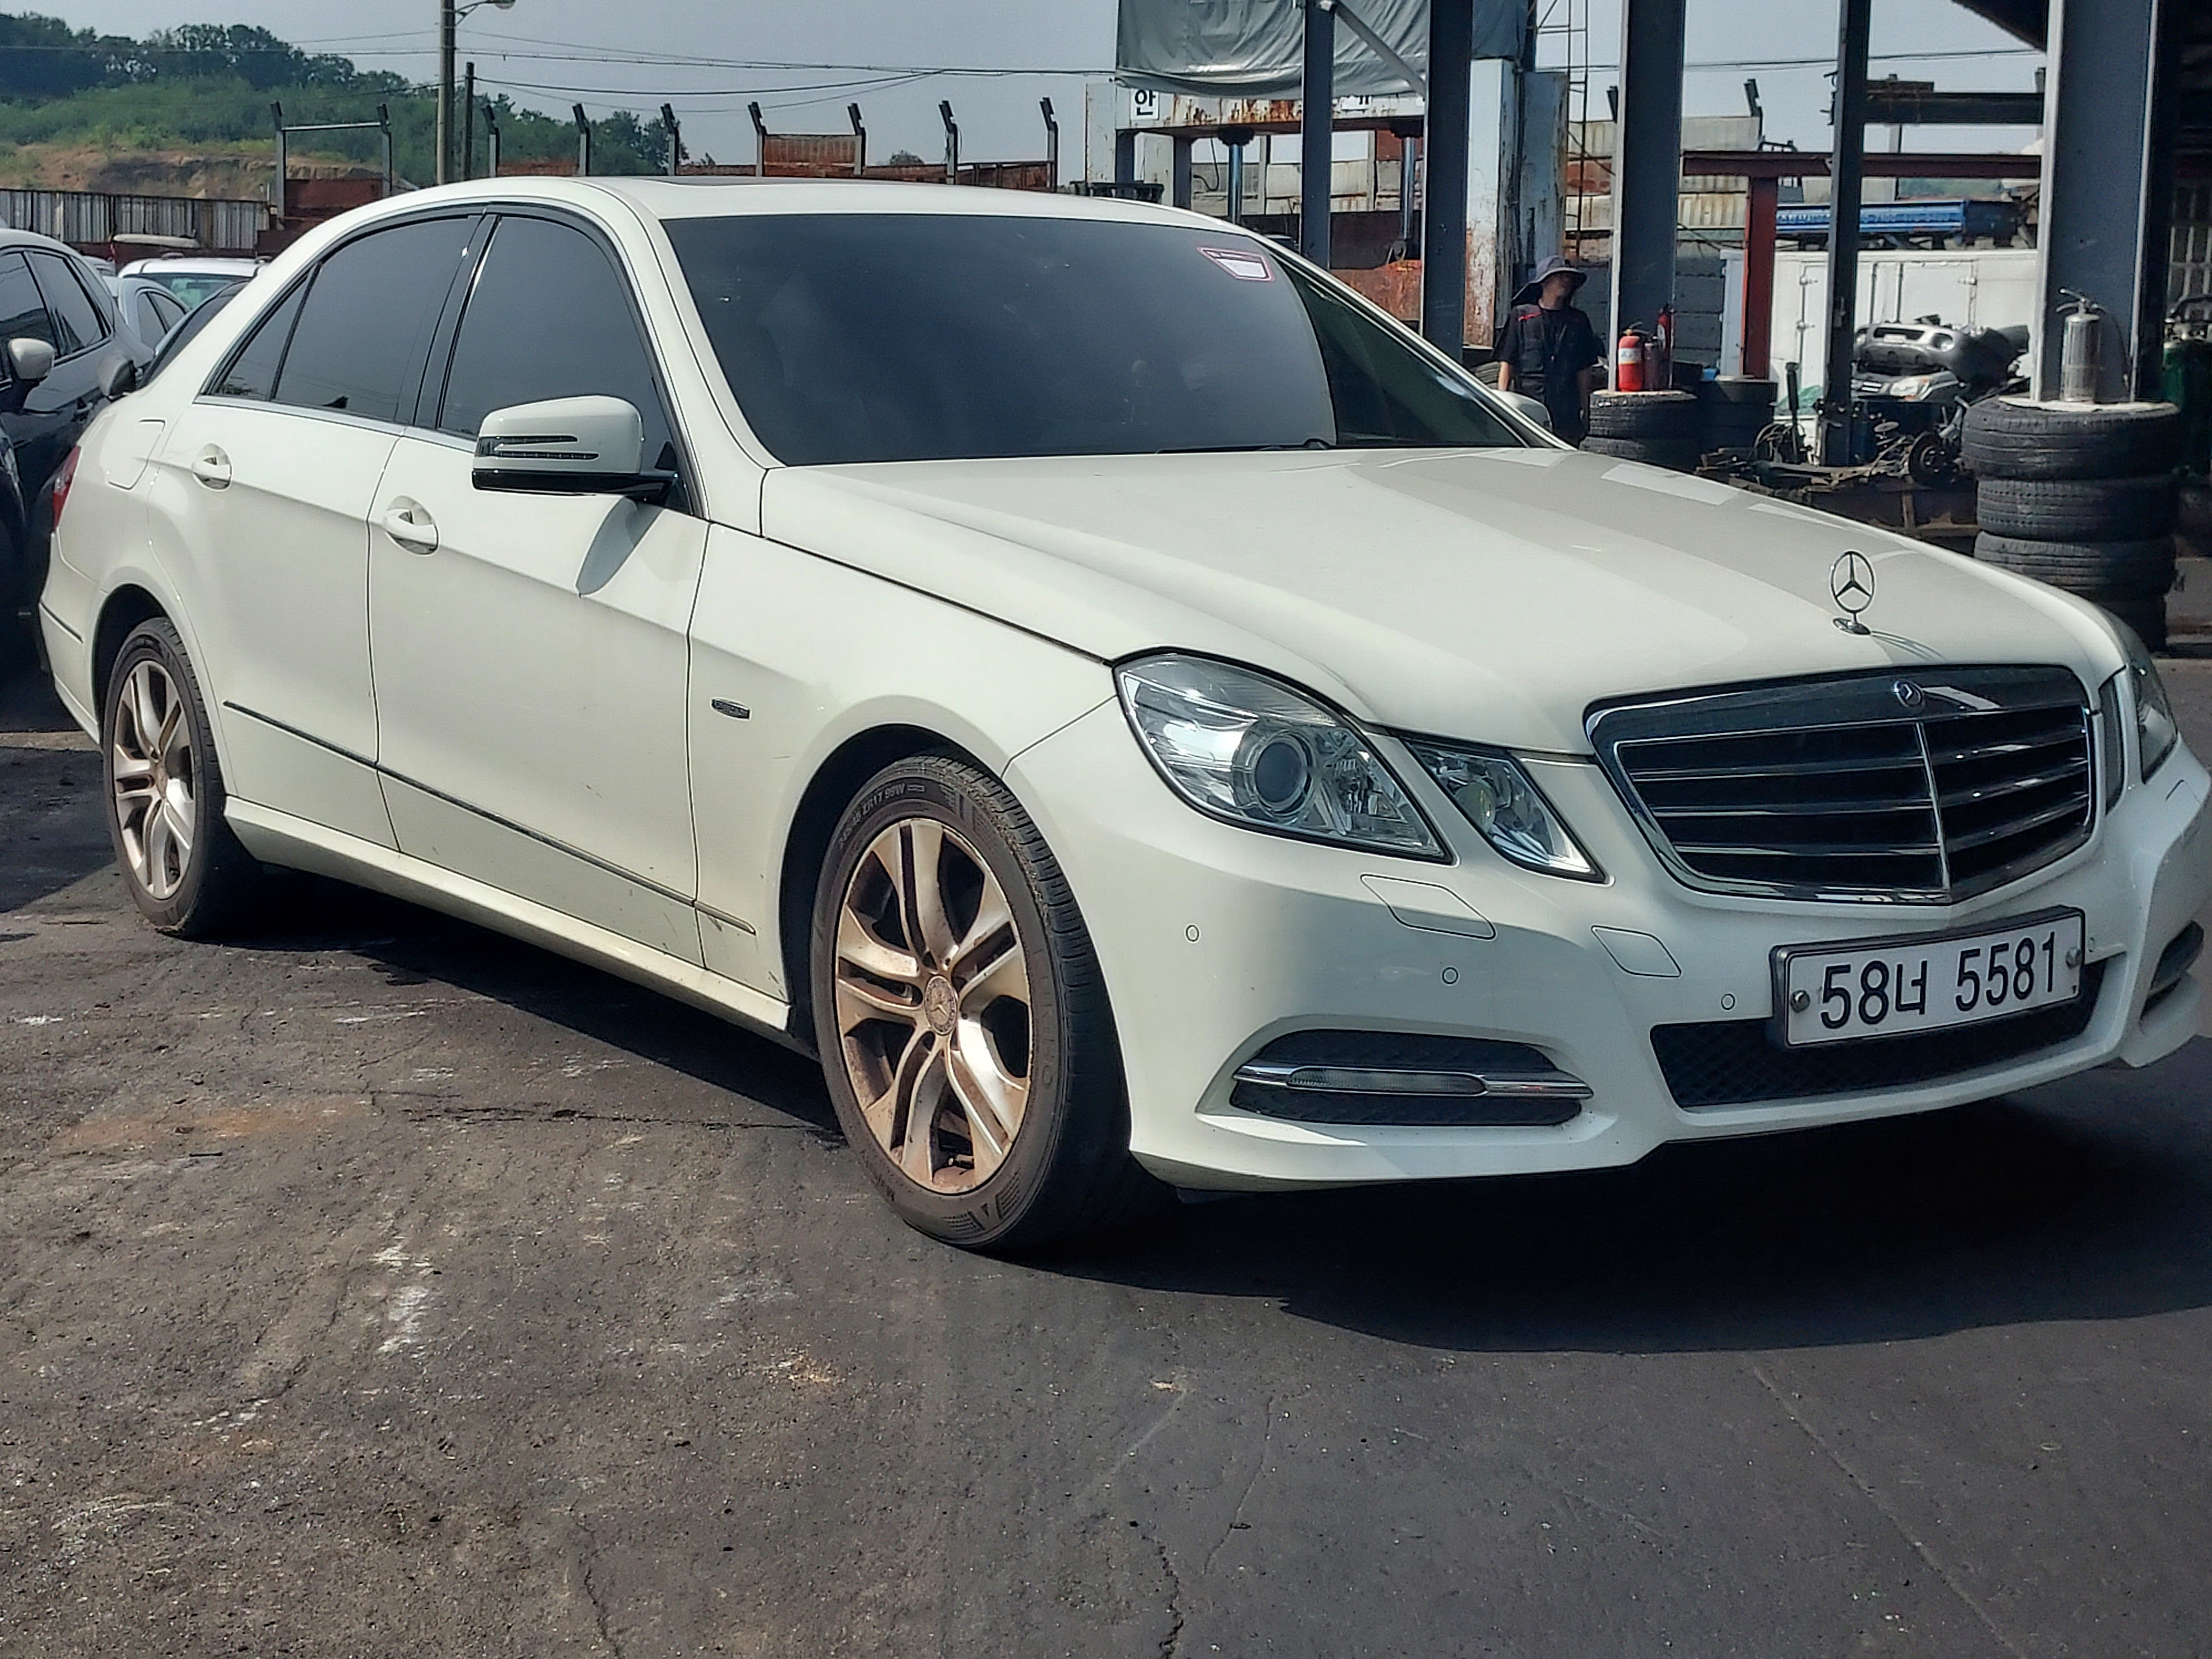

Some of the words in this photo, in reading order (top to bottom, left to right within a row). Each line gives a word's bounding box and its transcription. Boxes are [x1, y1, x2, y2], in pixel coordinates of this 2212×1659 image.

[1134, 89, 1156, 116] 안
[1820, 959, 1928, 1029] 58너
[1955, 931, 2056, 1011] 5581
